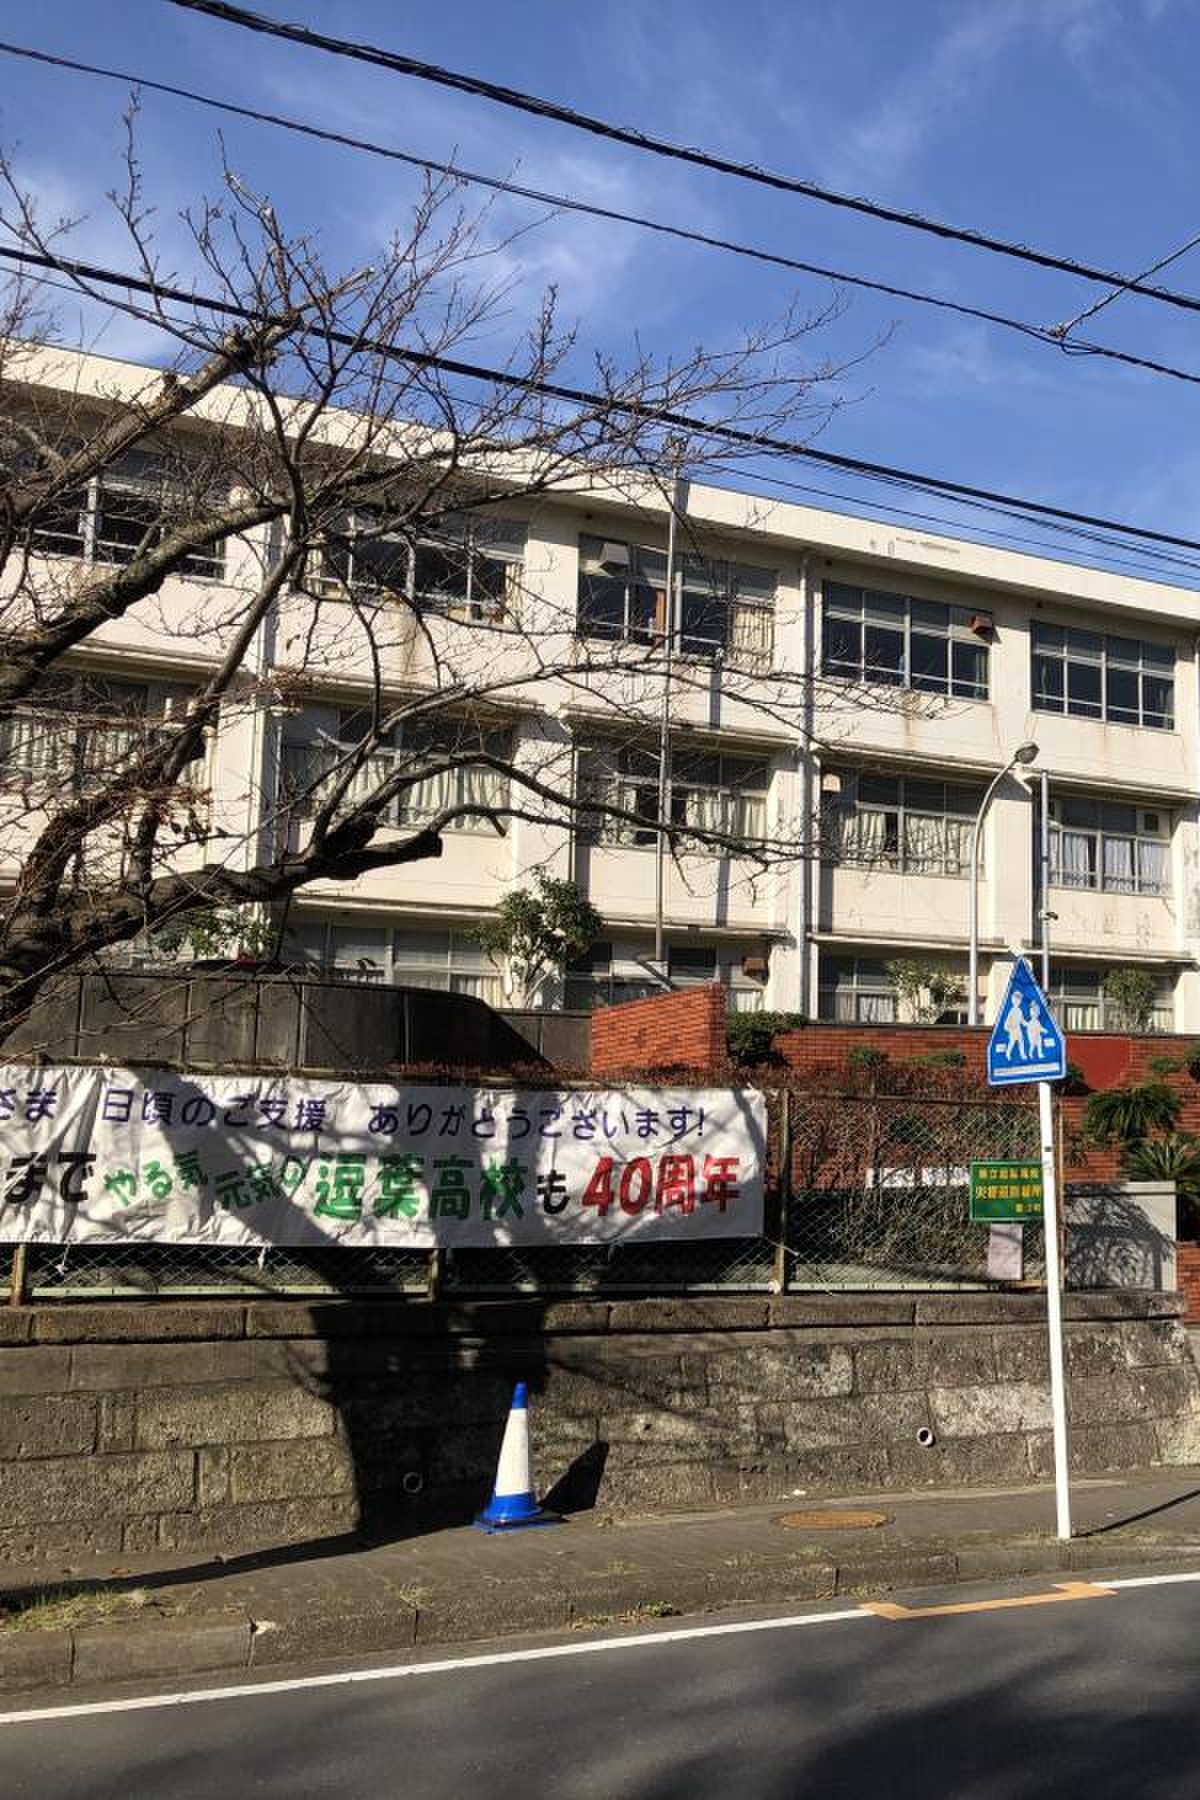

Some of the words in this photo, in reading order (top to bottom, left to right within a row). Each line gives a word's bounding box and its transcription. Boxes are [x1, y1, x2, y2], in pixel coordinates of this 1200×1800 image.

[101, 1087, 327, 1134] 日頃のご支援
